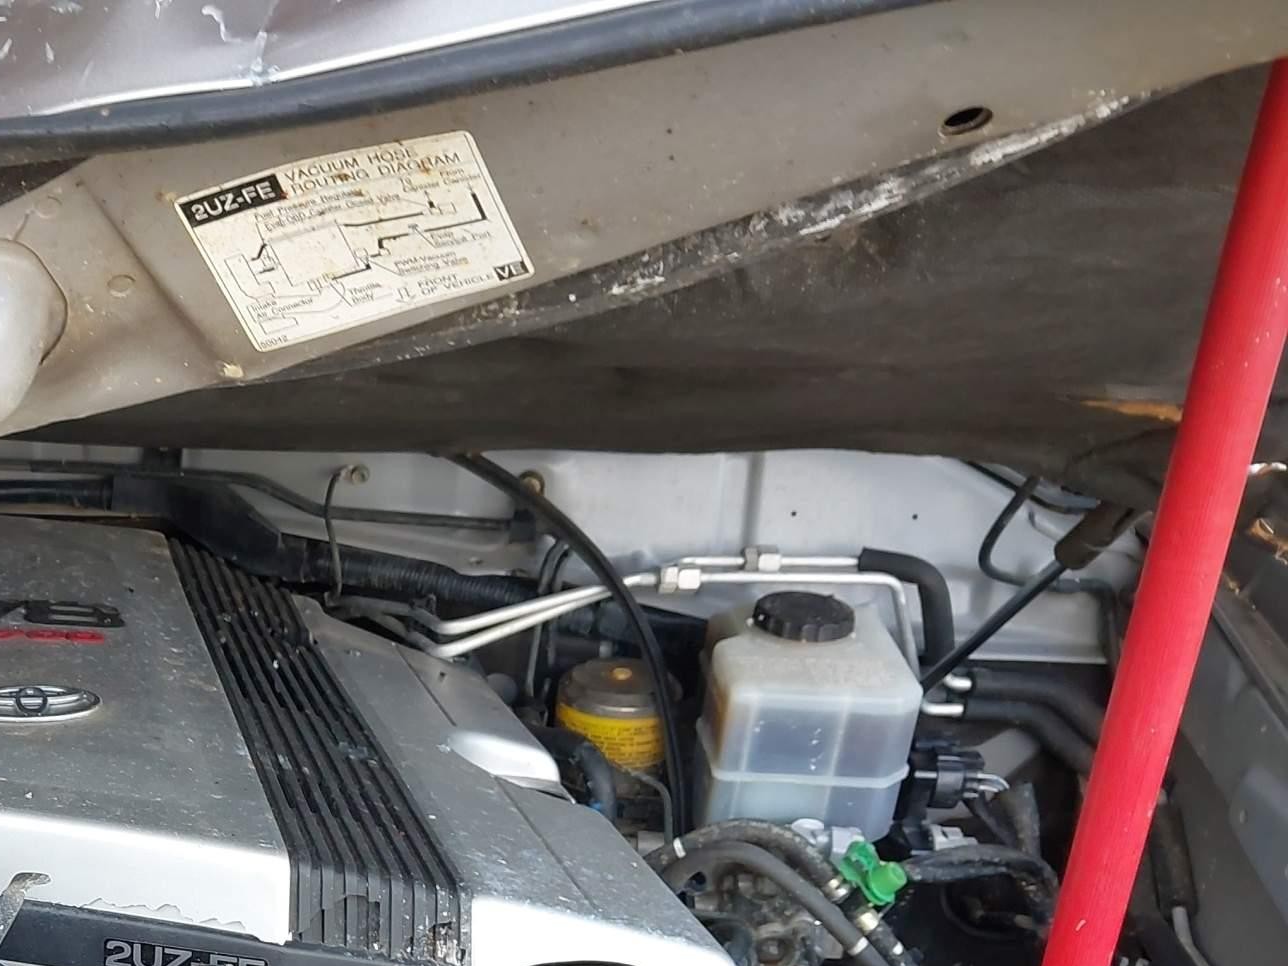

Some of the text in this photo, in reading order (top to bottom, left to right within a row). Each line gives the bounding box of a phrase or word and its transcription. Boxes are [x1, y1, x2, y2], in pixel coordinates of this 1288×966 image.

[285, 157, 360, 182] VACUUM
[291, 152, 461, 194] ROUTING DIAGRAM
[191, 181, 277, 221] 2UZ-FE
[417, 274, 459, 288] FRONT
[443, 274, 495, 290] VEHICLE
